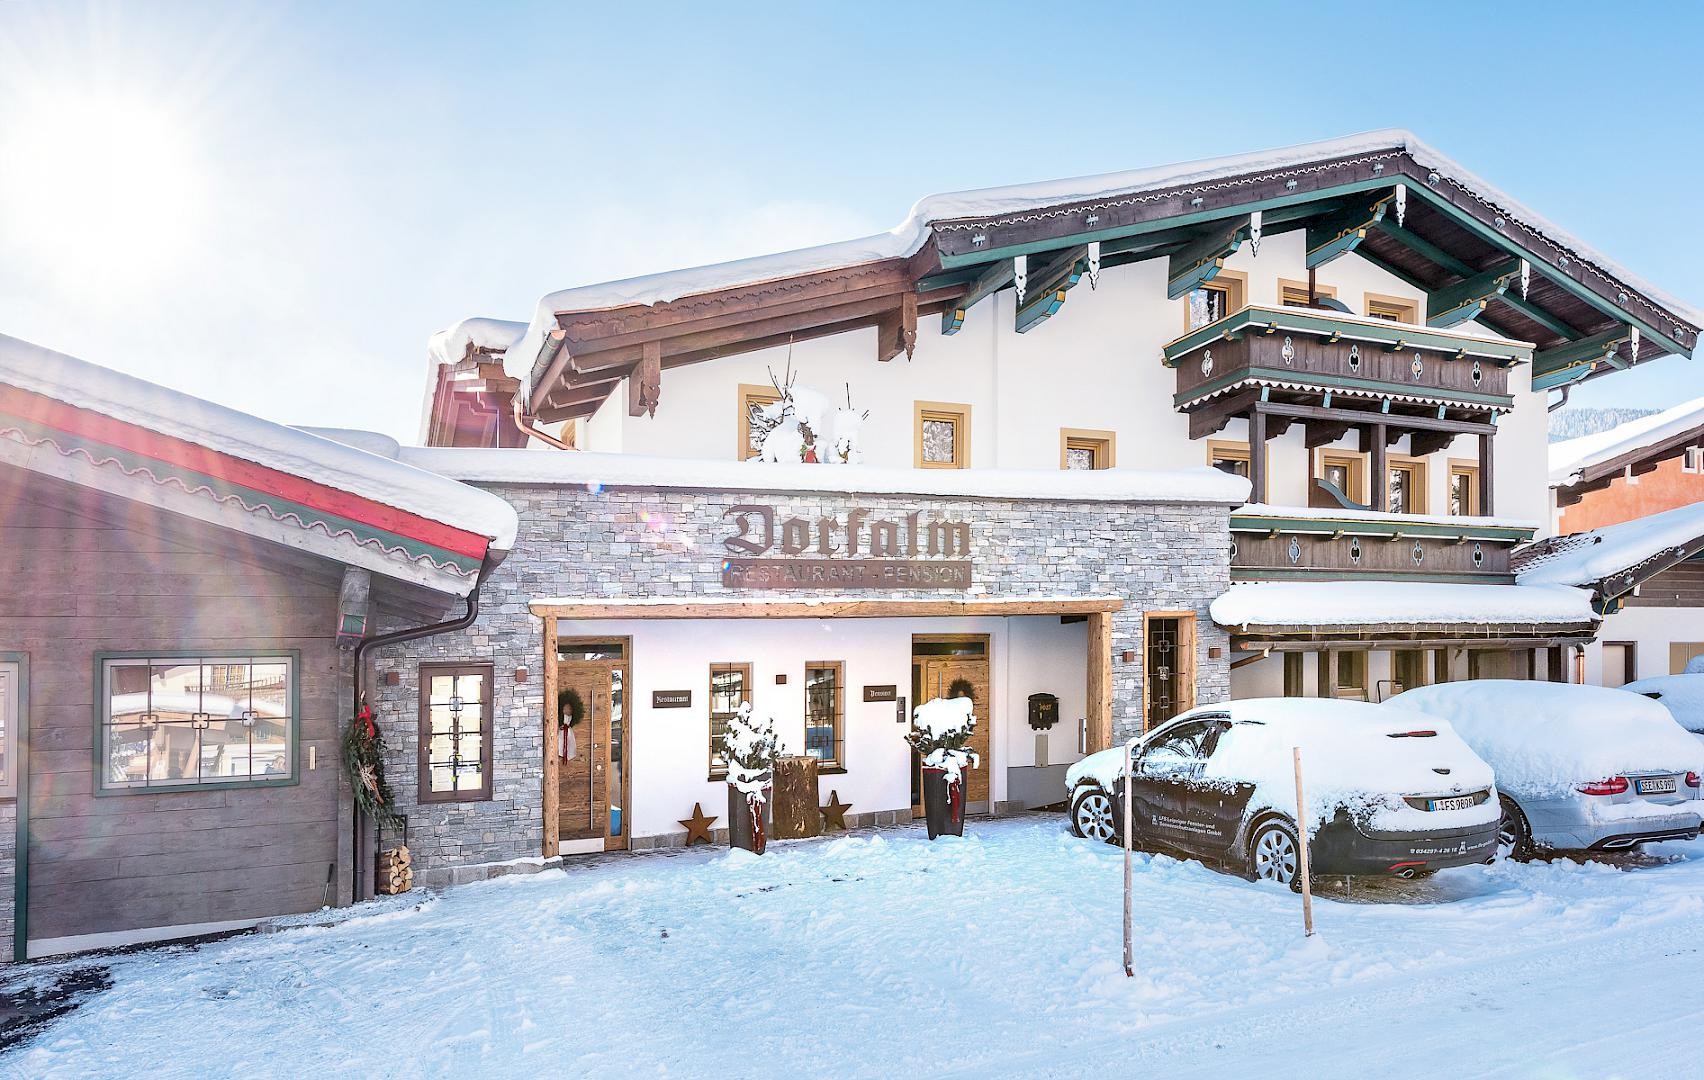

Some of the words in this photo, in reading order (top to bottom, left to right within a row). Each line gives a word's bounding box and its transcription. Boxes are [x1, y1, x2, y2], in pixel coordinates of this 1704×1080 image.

[723, 504, 972, 558] Dorfalm
[730, 565, 867, 583] RESTAURANT
[884, 566, 966, 583] PENSION
